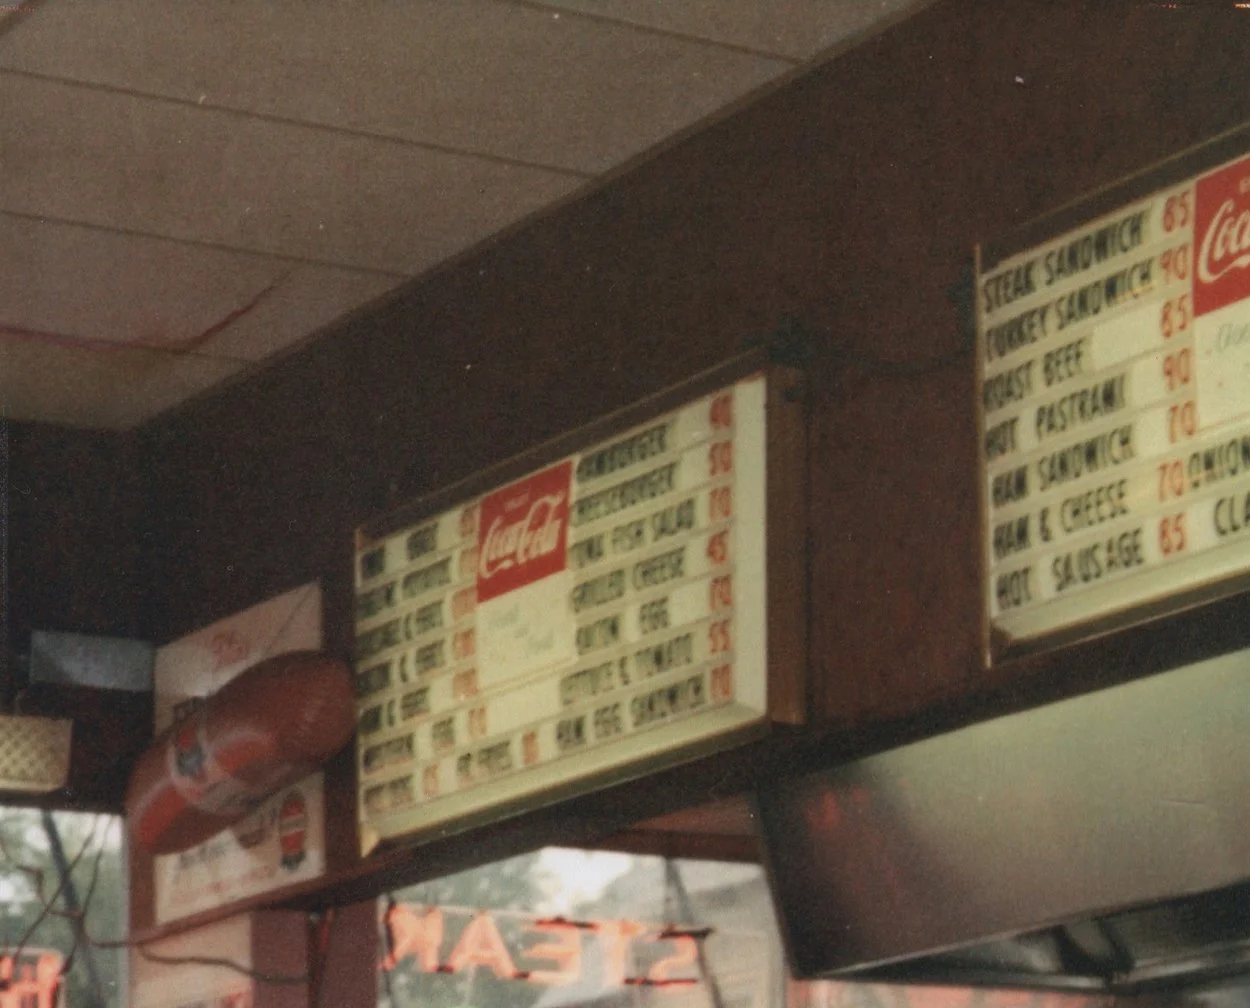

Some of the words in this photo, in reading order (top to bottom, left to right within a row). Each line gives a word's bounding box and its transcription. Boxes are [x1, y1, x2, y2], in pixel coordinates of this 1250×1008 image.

[984, 260, 1036, 313] STEAK
[1045, 211, 1144, 285] SANDWICH
[985, 302, 1051, 362] TURKEY
[1056, 258, 1154, 331] SANDWICH
[1160, 244, 1190, 284] 90
[983, 360, 1034, 411] ROAST
[1044, 337, 1086, 387] BEEF
[985, 417, 1019, 462] HOT
[1037, 373, 1127, 441] PASTRAMI
[1162, 348, 1191, 391] 90
[992, 465, 1030, 508] HAM
[1038, 424, 1136, 492] SANDWICH
[1168, 401, 1196, 443] 70
[993, 514, 1031, 560] HAM
[1060, 478, 1129, 533] CHEESE
[1158, 459, 1185, 501] 70
[996, 566, 1032, 610] HOT
[1053, 527, 1144, 592] SAUSAGE
